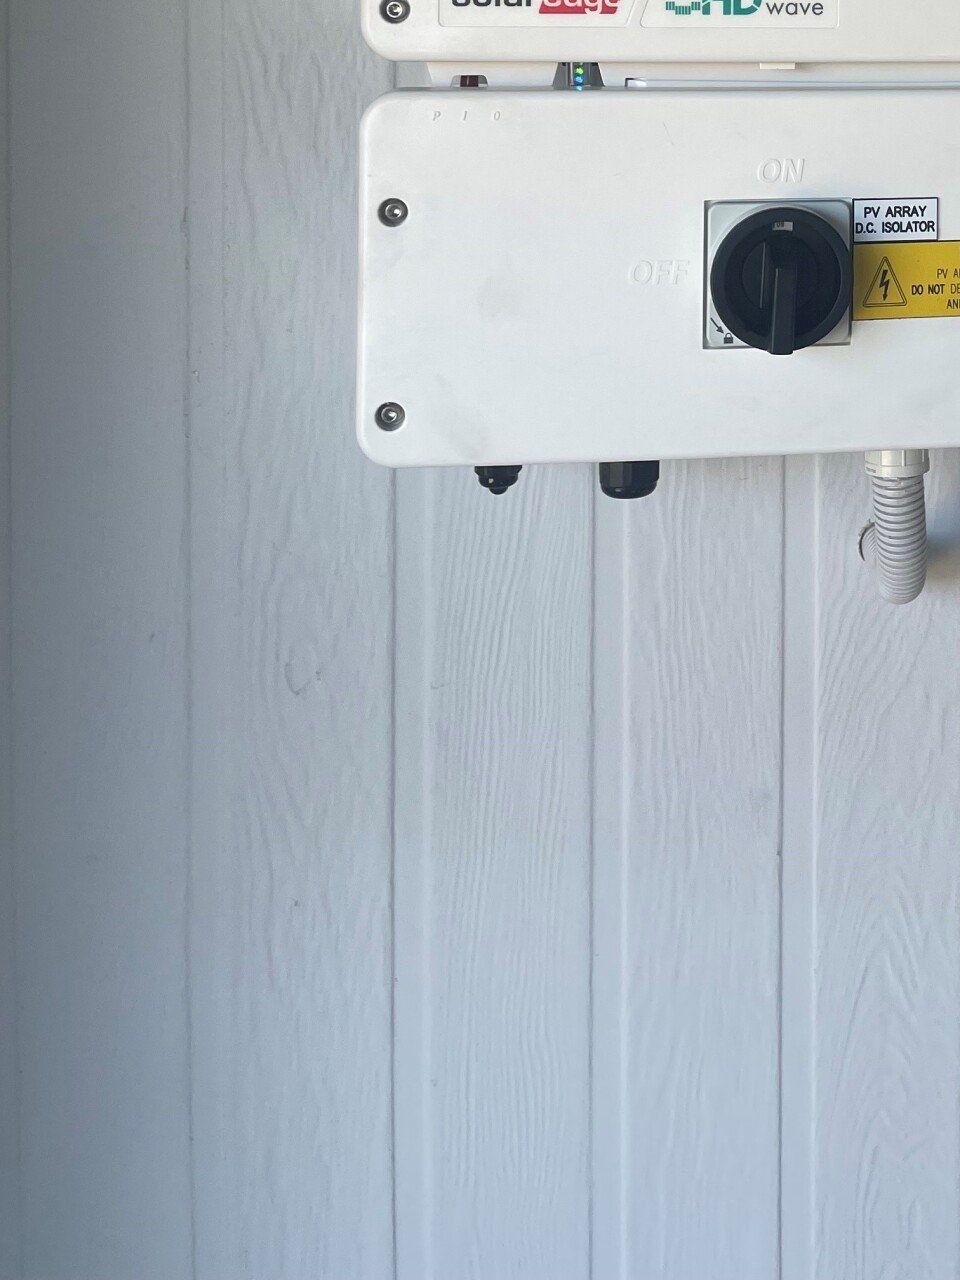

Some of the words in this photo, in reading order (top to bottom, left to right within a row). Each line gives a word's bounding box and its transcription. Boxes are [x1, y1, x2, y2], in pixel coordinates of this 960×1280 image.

[766, 0, 823, 16] wave
[757, 158, 805, 183] ON
[864, 206, 880, 218] PV
[885, 206, 927, 218] ARRAY
[856, 222, 876, 234] D.C.
[882, 221, 935, 233] ISOLATOR
[629, 260, 690, 285] OFF
[937, 268, 947, 279] PV
[912, 285, 923, 295] DO
[928, 284, 944, 294] NOT
